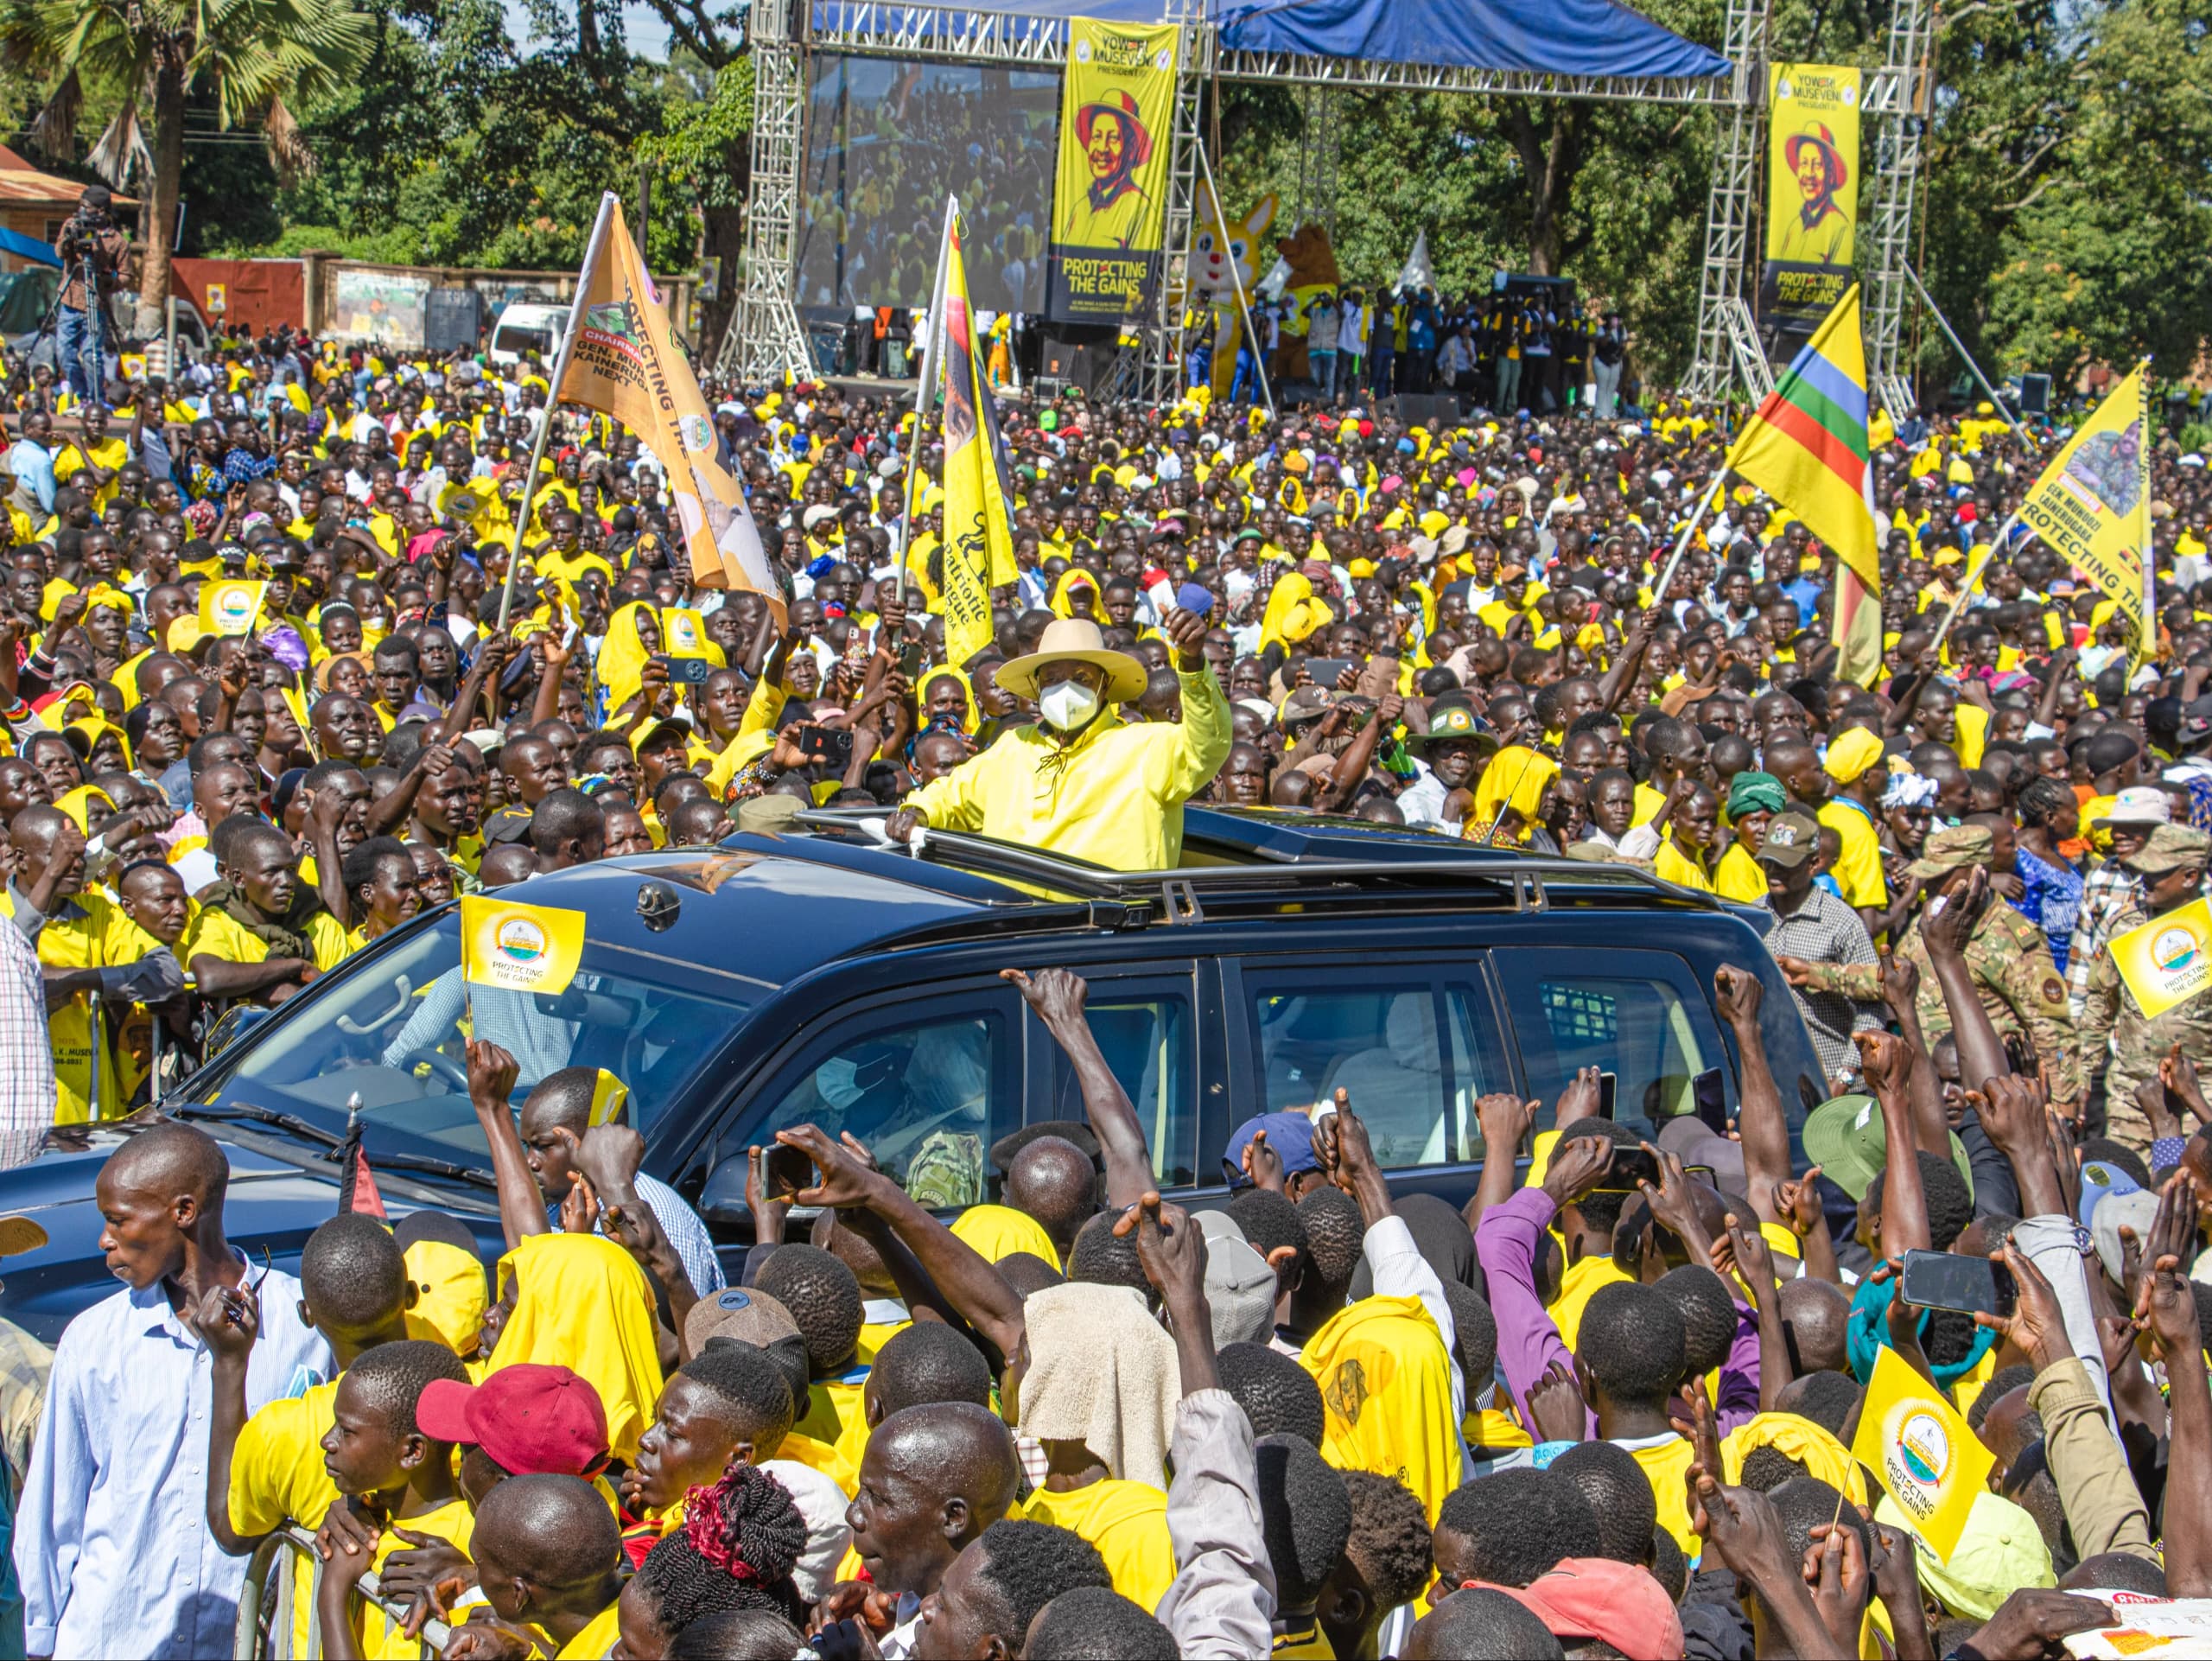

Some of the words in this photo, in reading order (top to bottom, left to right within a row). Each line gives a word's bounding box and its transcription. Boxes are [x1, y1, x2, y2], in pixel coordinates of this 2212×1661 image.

[1063, 258, 1147, 278] PROTECTING
[1069, 275, 1096, 293] THE
[1098, 277, 1140, 295] GAINS
[1777, 271, 1845, 290] PROTECTING
[1778, 286, 1802, 302] THE
[576, 340, 612, 358] GEN.
[593, 365, 632, 387] NEXT
[944, 541, 986, 622] Patriotic
[493, 960, 544, 978] PROTECTING
[497, 971, 510, 979] THE
[2164, 961, 2210, 990] PROTECTING
[2171, 983, 2187, 996] THE
[2187, 971, 2210, 987] GAINS
[1887, 1456, 1936, 1515] PROTECTING
[1888, 1473, 1903, 1495] THE
[1901, 1490, 1927, 1521] GAINS
